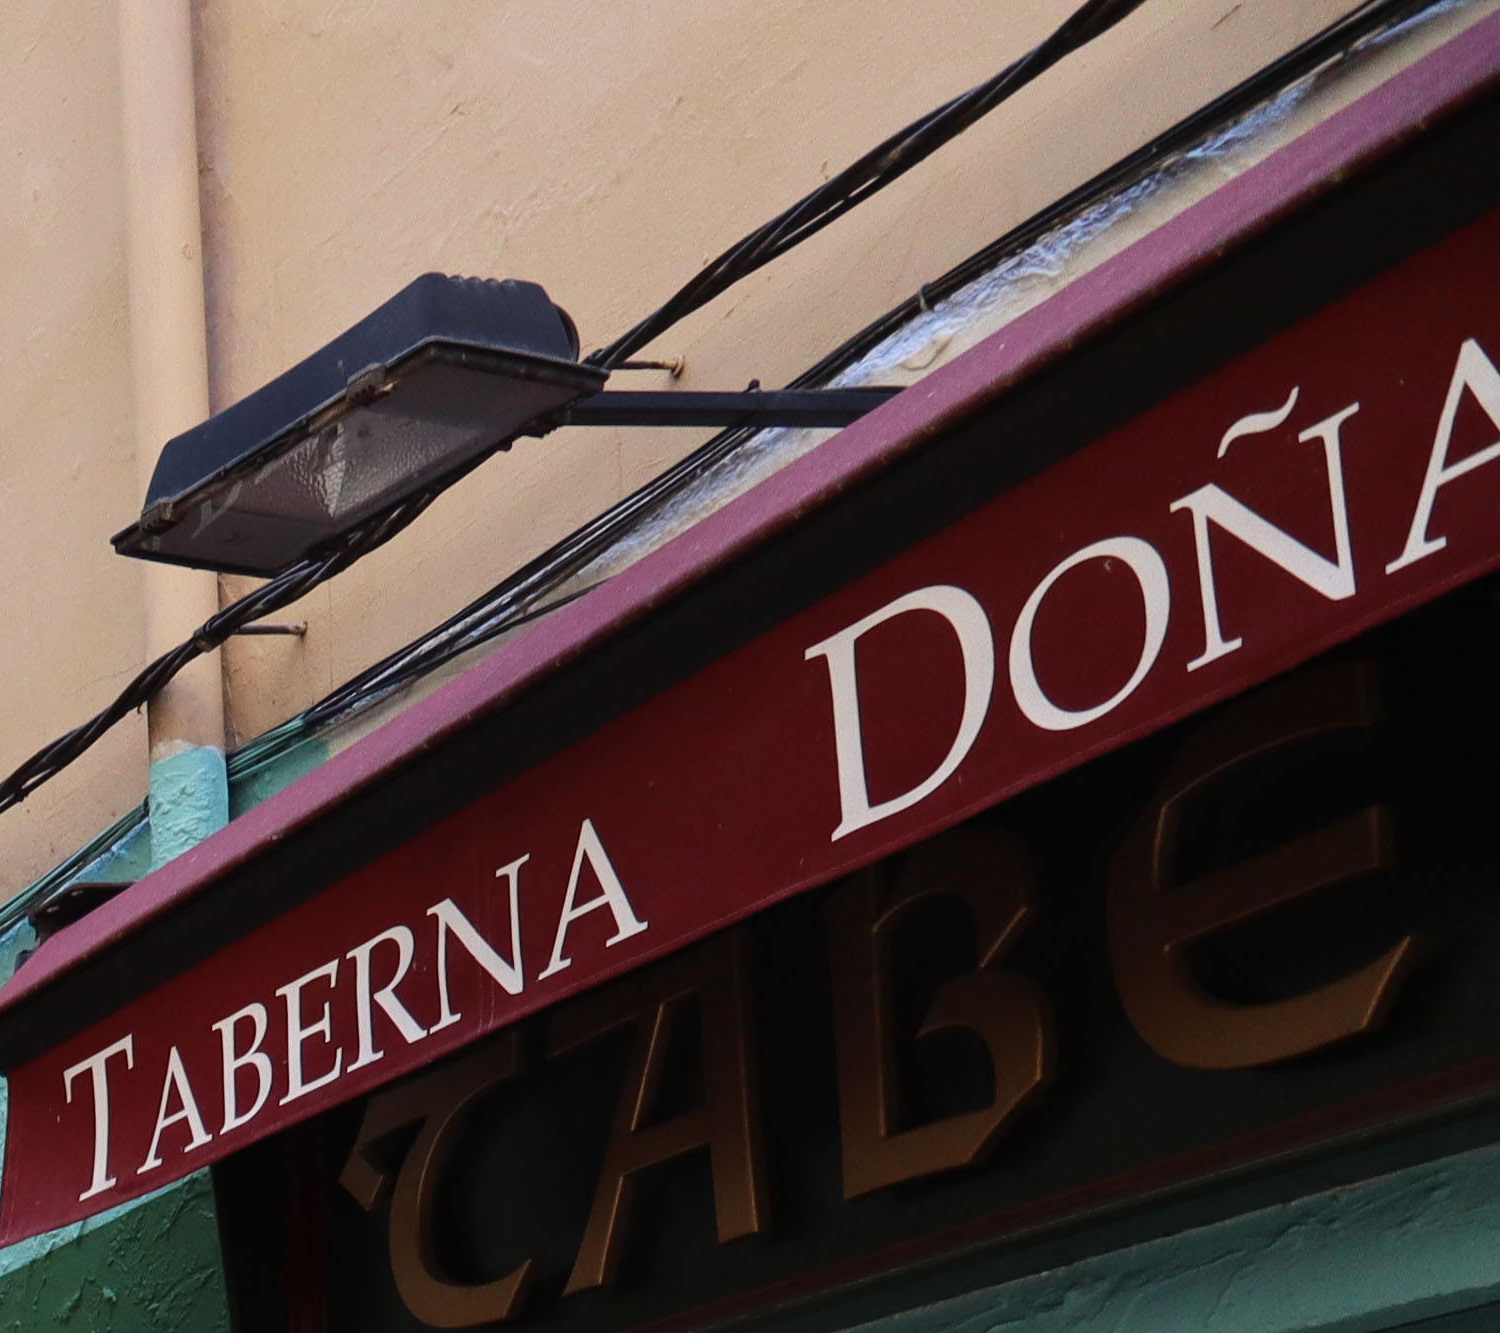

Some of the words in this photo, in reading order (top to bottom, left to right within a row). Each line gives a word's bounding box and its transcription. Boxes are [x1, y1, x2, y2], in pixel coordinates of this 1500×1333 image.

[63, 818, 648, 1200] TABERNA
[804, 337, 1500, 842] DOÑA
[339, 658, 1415, 1329] TABE
